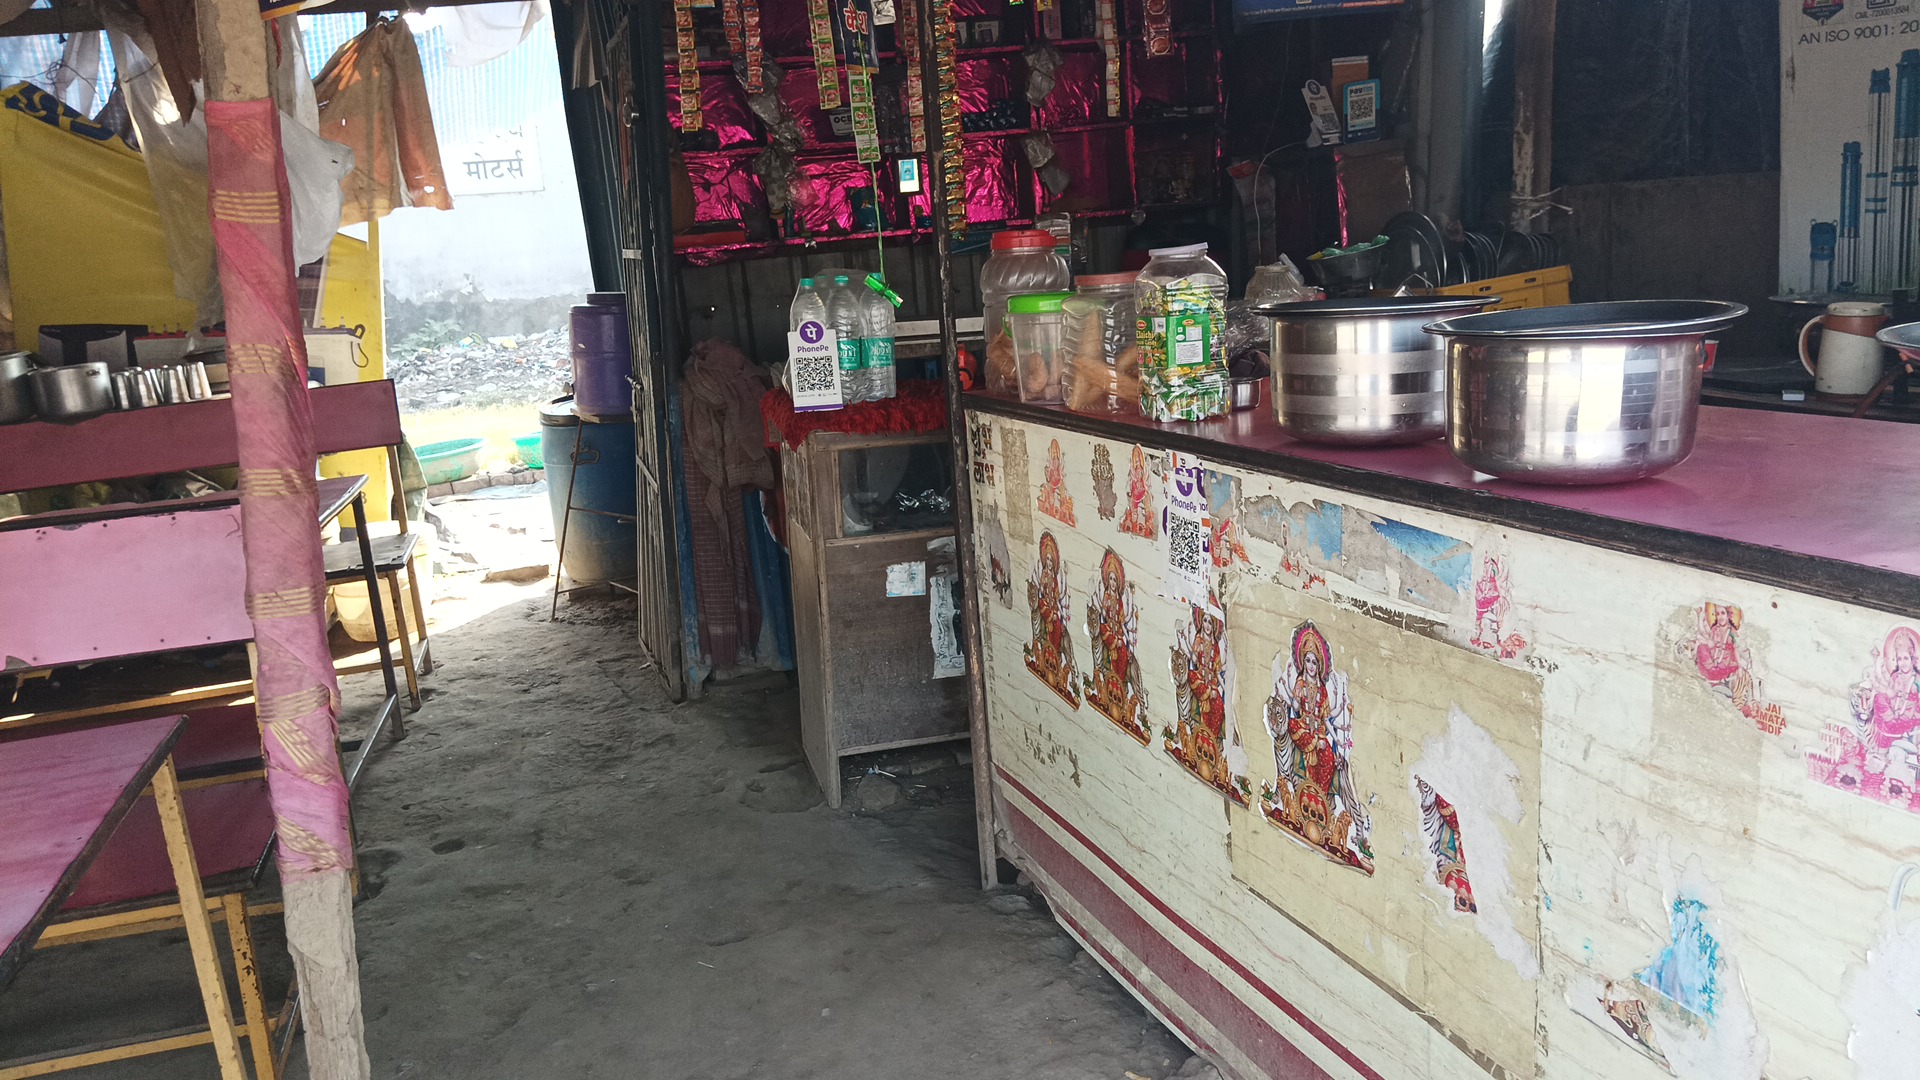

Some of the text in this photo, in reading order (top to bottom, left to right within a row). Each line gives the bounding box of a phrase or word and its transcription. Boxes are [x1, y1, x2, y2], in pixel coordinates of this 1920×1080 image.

[1798, 32, 1821, 45] AN
[1825, 29, 1850, 43] ISO
[1854, 24, 1894, 39] 9001:
[463, 149, 523, 180] मोटर्स
[797, 344, 829, 353] PhonePe
[1171, 494, 1197, 513] PhonePe
[1765, 703, 1782, 715] JAI
[1759, 711, 1787, 728] MATA
